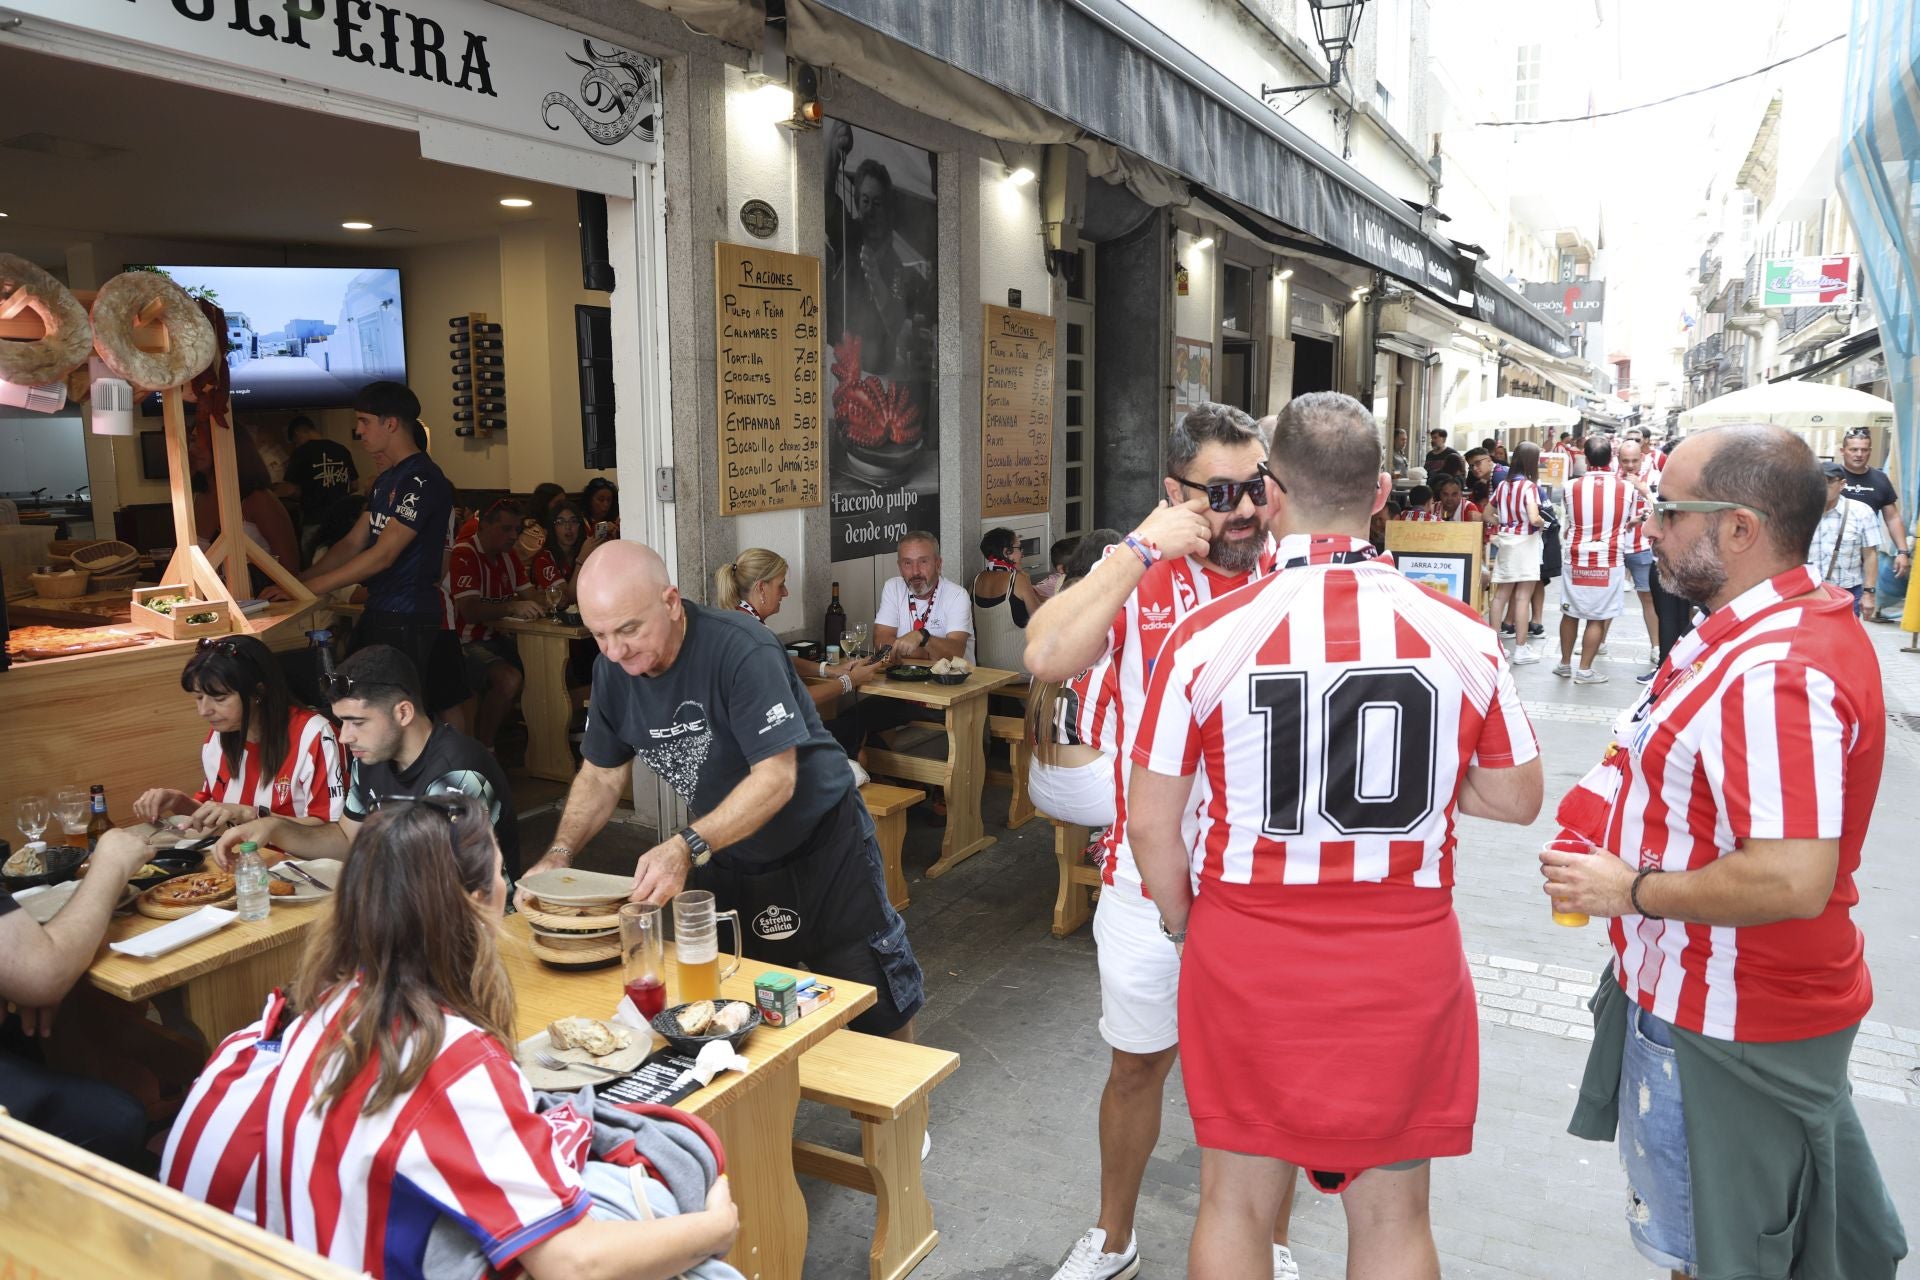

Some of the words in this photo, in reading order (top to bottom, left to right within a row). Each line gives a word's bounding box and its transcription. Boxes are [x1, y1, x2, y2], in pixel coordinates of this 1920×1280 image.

[128, 0, 498, 98] LPEIRA
[1353, 212, 1360, 240] A
[1365, 219, 1386, 254] NOVA
[724, 294, 751, 318] PULPO
[723, 325, 777, 339] CALAMARES
[795, 323, 817, 340] 8,80
[724, 371, 771, 383] CROQUETAS
[726, 412, 780, 431] EMPANADA
[987, 413, 1018, 428] EMPANADA
[778, 454, 802, 473] JAMÓN
[831, 488, 883, 513] Facendo
[886, 486, 918, 514] pulpo
[845, 520, 881, 544] dende
[883, 522, 908, 543] 1979
[1411, 561, 1432, 569] JARRA
[1433, 562, 1452, 570] 2,70€
[1141, 622, 1173, 630] adidas
[1249, 666, 1438, 836] 10
[760, 914, 792, 926] Estrella
[762, 922, 793, 933] Galicia
